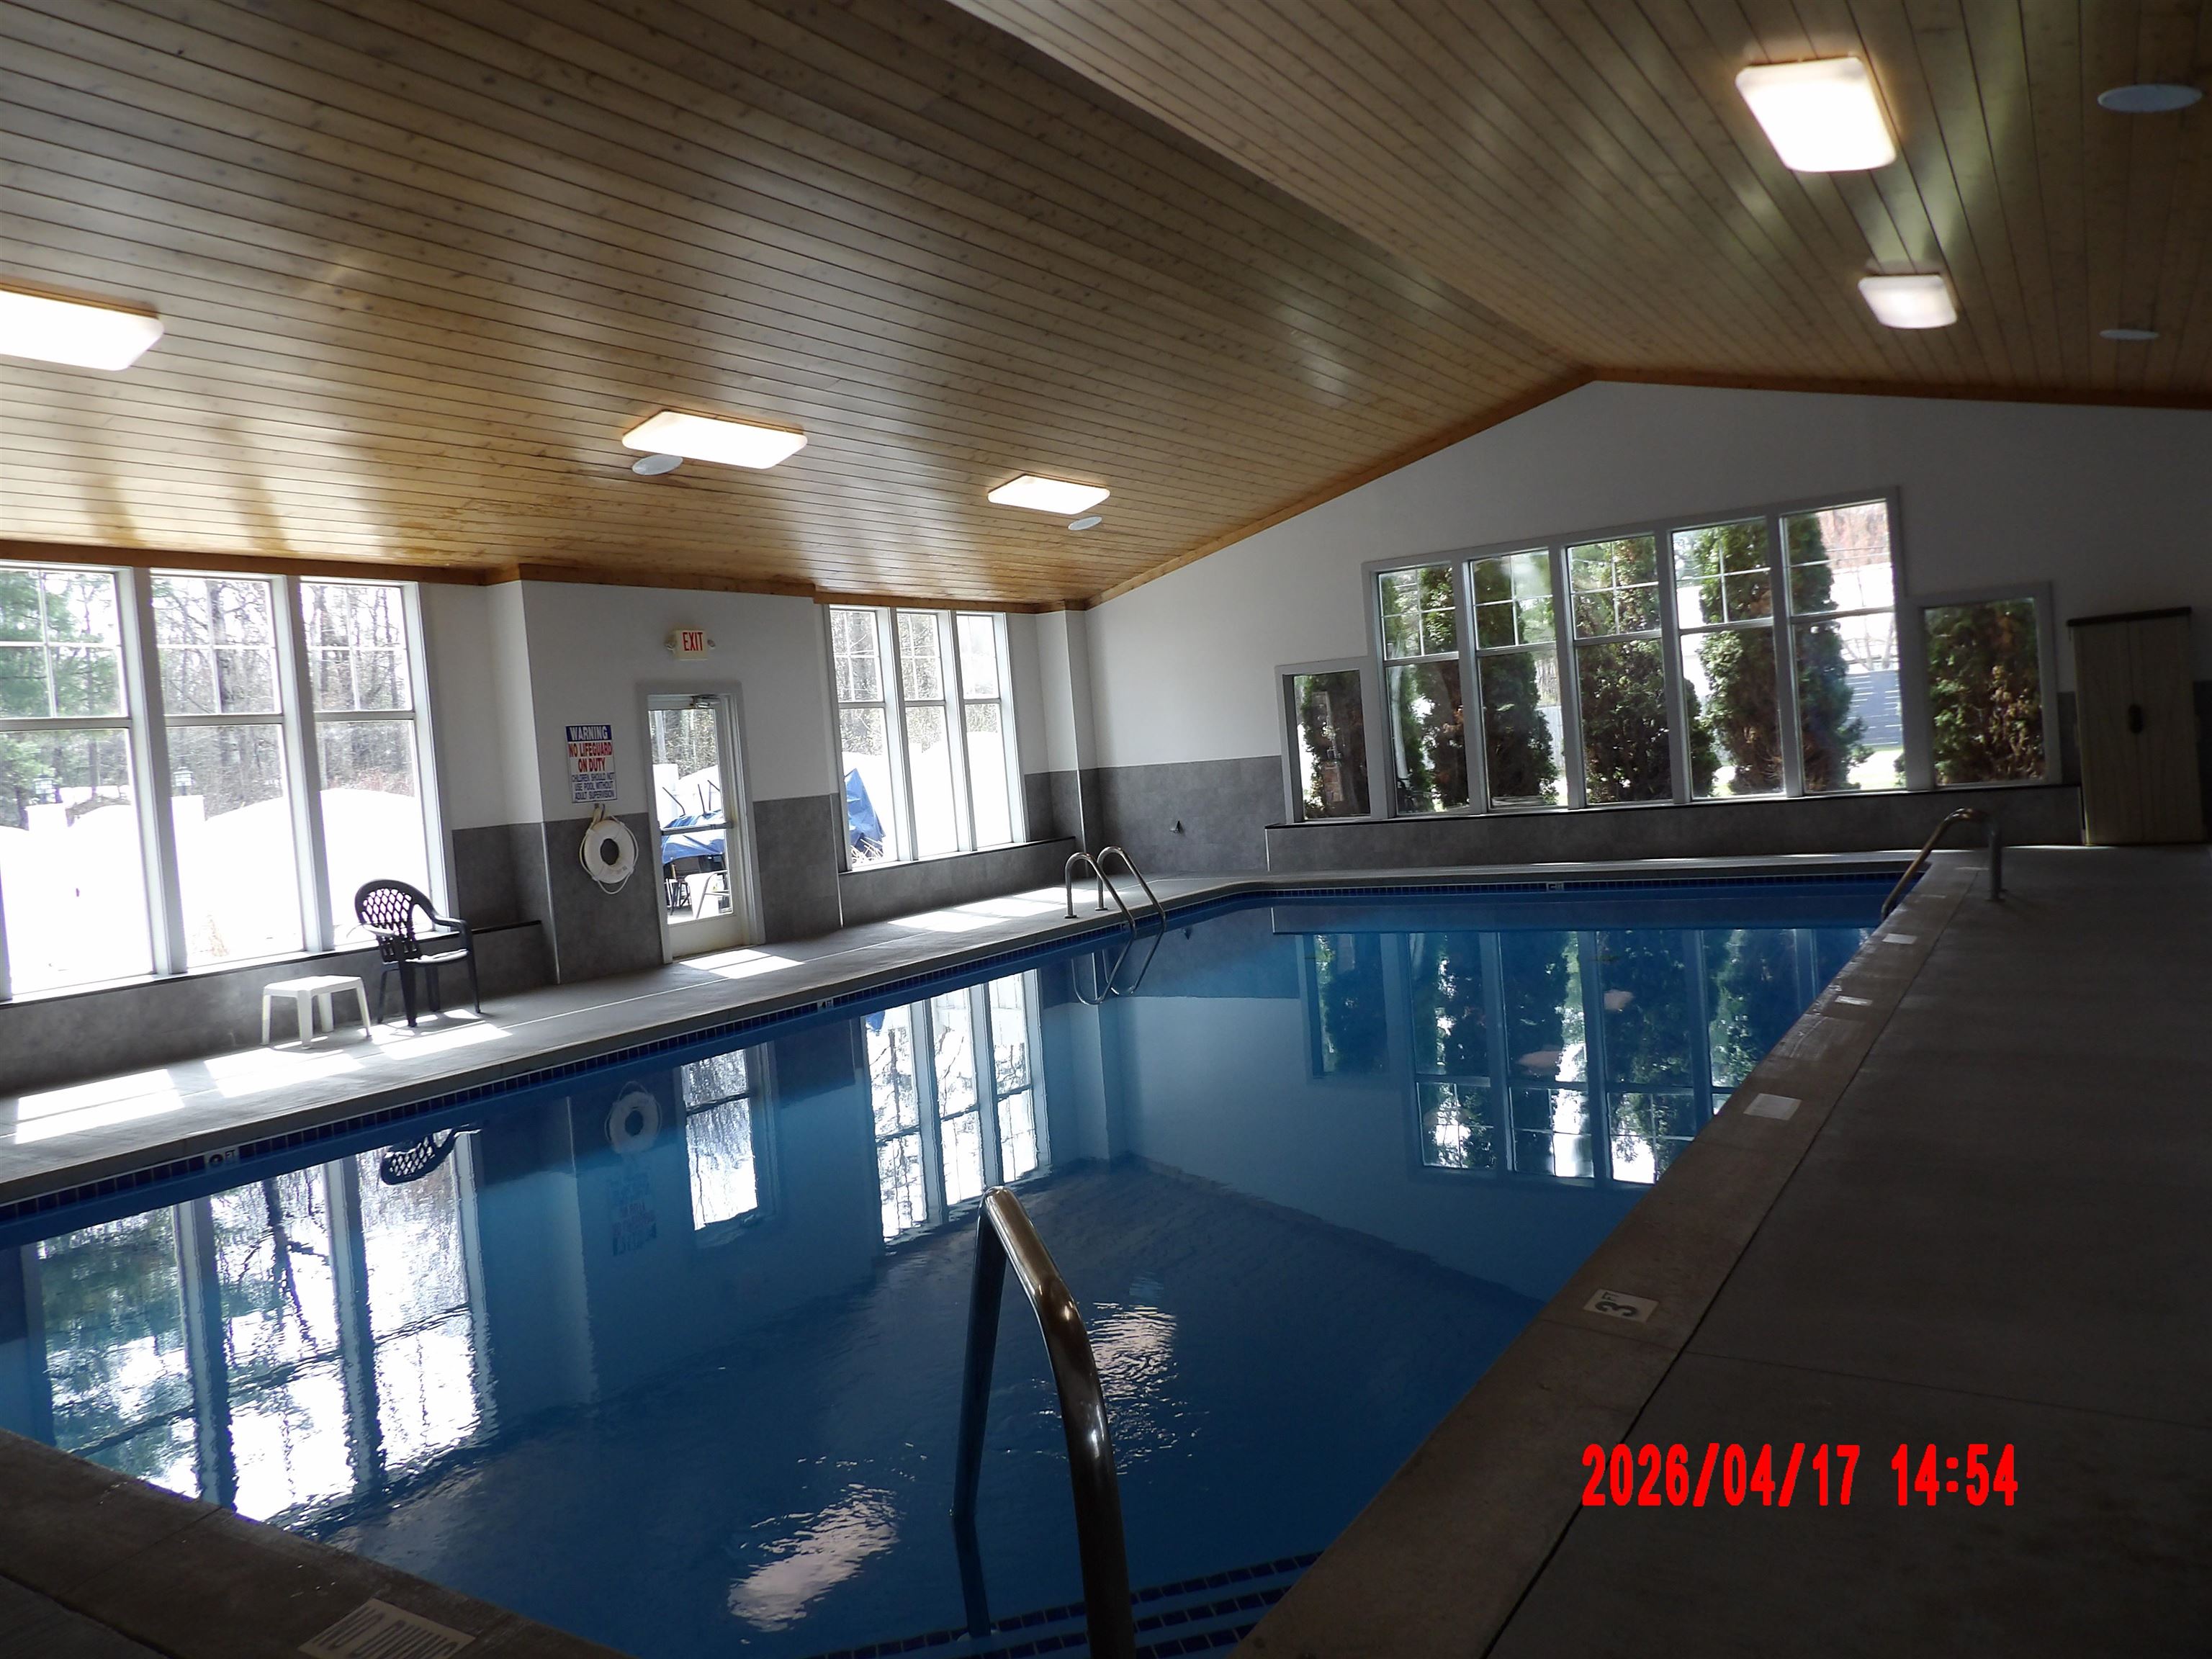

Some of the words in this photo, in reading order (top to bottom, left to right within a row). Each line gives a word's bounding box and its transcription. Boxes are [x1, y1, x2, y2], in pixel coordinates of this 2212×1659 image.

[683, 631, 703, 652] EXIT
[570, 725, 608, 740] WARNING
[568, 742, 578, 757] NO
[580, 742, 612, 757] LIFEGUARD
[578, 758, 588, 773] ON
[588, 757, 606, 772] DUTY
[572, 773, 590, 782] CHILDREN
[590, 773, 606, 781] SHOULD
[584, 782, 595, 791] POOL
[595, 781, 613, 789] WITHOUT
[575, 791, 587, 800] ADULT
[588, 790, 615, 799] SUPERVISION
[1595, 1301, 1638, 1317] 3
